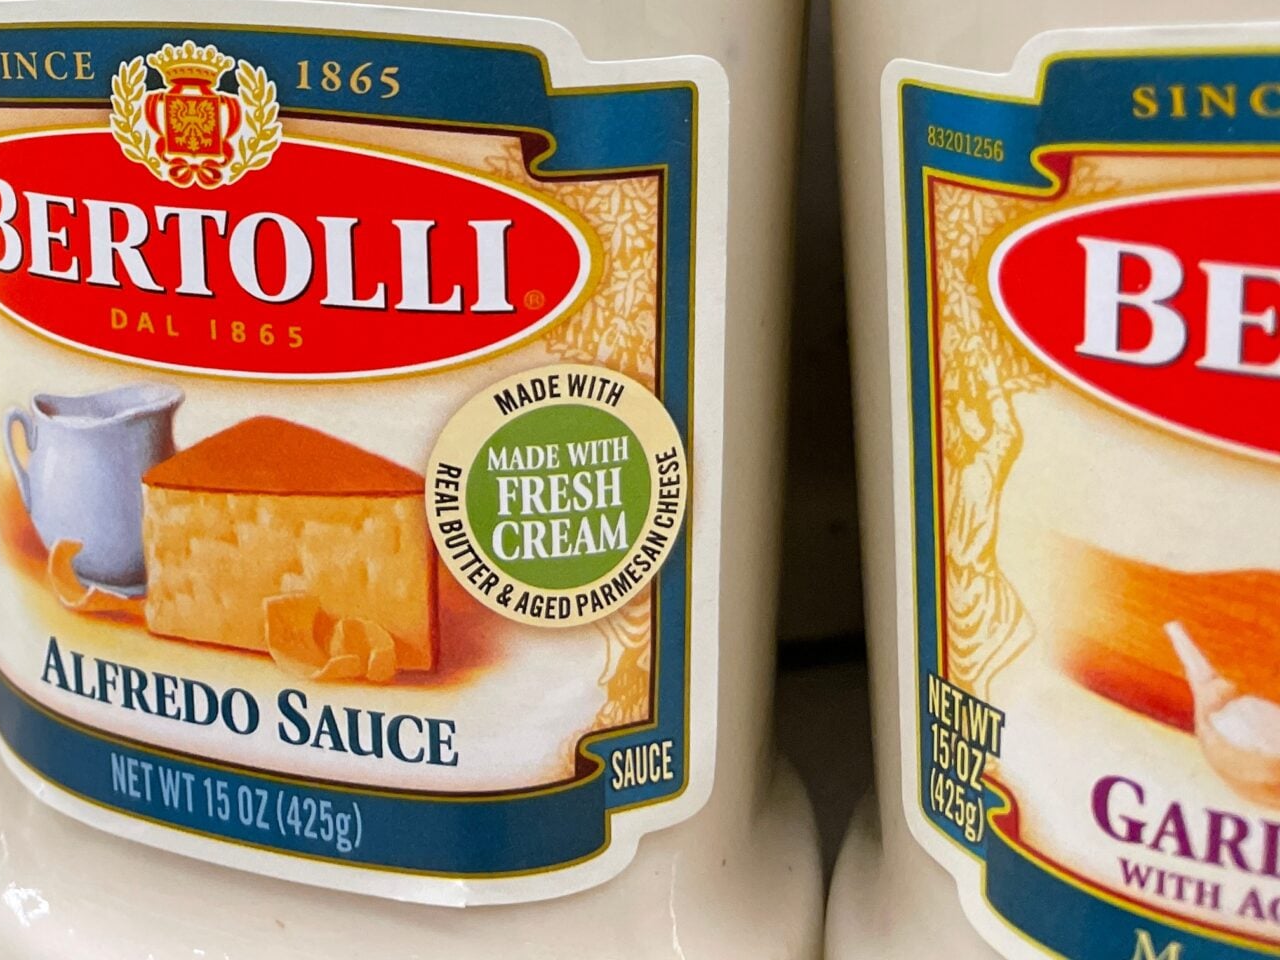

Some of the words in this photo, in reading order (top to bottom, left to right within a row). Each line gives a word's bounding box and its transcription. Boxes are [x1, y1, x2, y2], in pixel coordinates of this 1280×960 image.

[296, 59, 402, 98] 1865
[927, 125, 1004, 162] 83201256
[111, 307, 180, 337] DAL
[210, 321, 303, 348] 1865
[493, 374, 562, 416] MADE
[567, 373, 625, 407] WITH
[487, 444, 560, 471] MADE
[567, 436, 630, 467] WITH
[434, 462, 463, 517] REAL
[496, 467, 623, 516] FRESH
[654, 446, 681, 529] CHEESE
[438, 518, 501, 596] BUTTER
[492, 510, 630, 561] CREAM
[496, 584, 514, 608] &
[576, 531, 669, 617] PARMESAN
[514, 591, 571, 620] AGED
[40, 635, 260, 735] ALFREDO
[277, 688, 460, 767] SAUCE
[928, 673, 963, 731] NET
[968, 698, 1002, 753] WT
[612, 740, 674, 790] SAUCE
[931, 722, 949, 770] 15
[956, 740, 984, 792] OZ
[111, 752, 153, 794] NET
[159, 768, 195, 813] WT
[203, 781, 231, 821] 15
[238, 789, 270, 830] OZ
[277, 794, 363, 852] (425g)
[930, 767, 985, 842] (425g)
[1118, 857, 1221, 911] WITH
